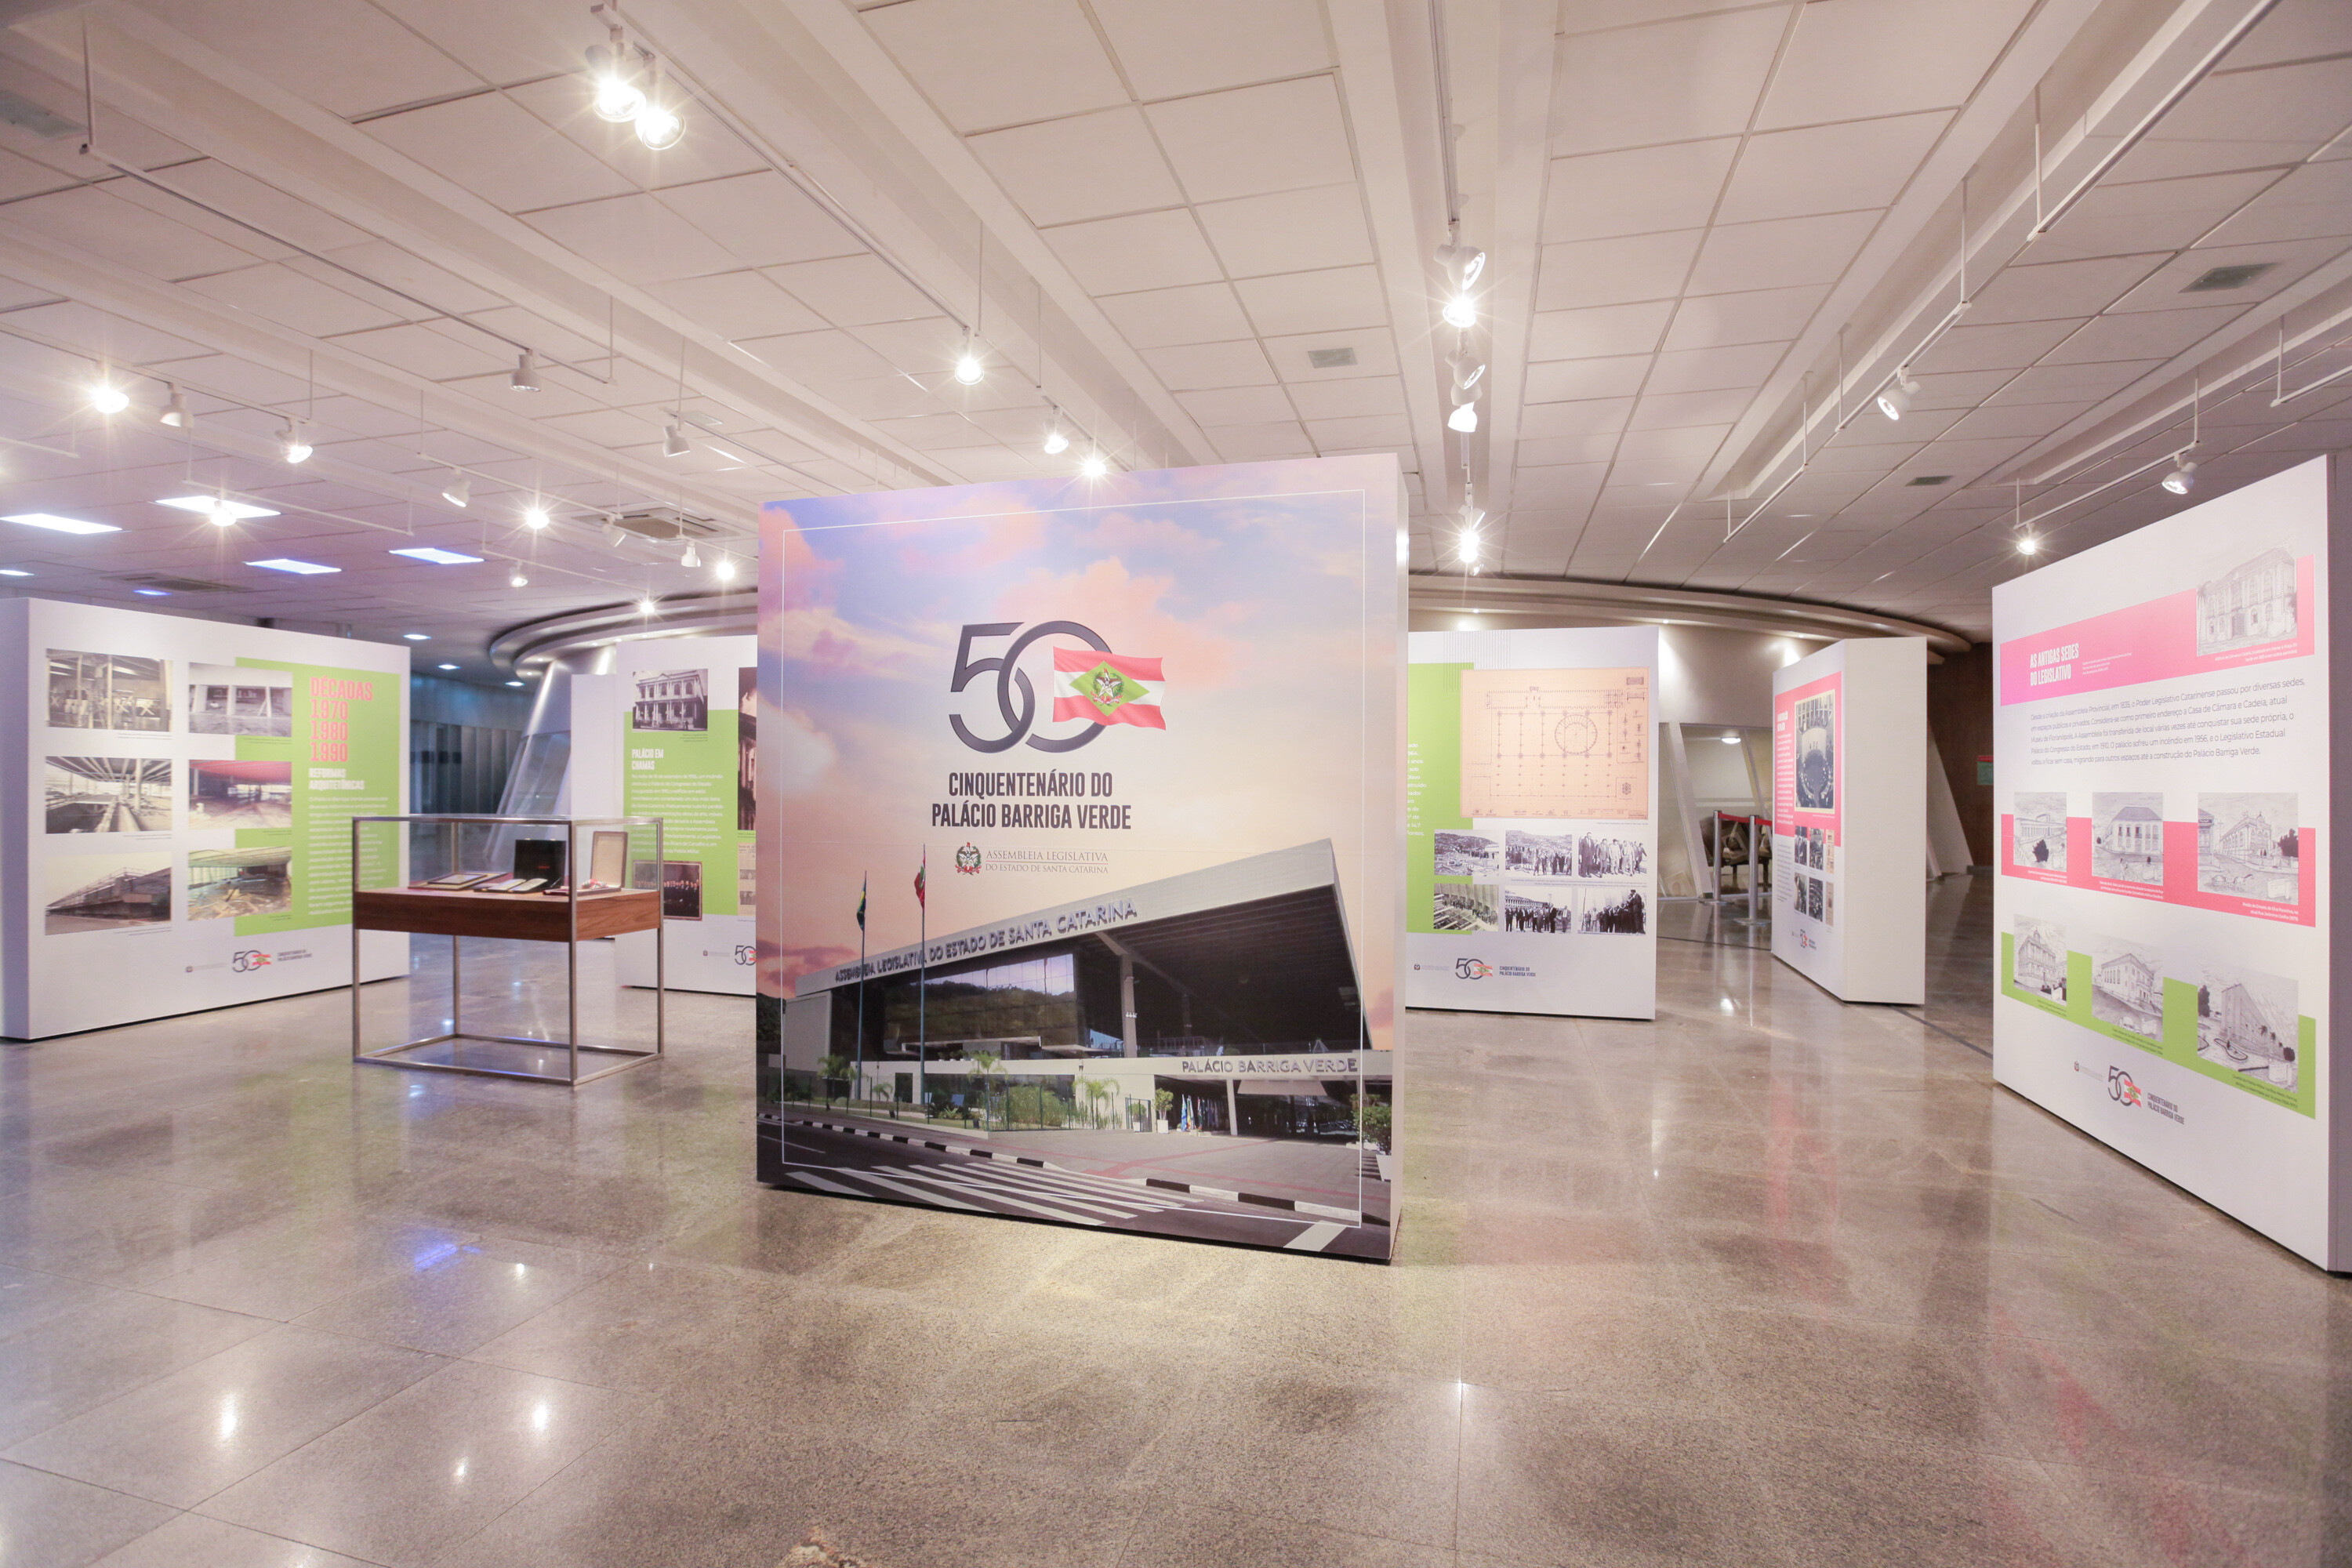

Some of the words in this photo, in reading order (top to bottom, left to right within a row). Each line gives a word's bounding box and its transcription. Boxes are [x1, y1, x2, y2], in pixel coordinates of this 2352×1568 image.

[2031, 653, 2038, 669] AS
[2038, 648, 2060, 666] ANTIGAS
[2061, 643, 2079, 662] SEDES
[2031, 671, 2038, 686] DO
[2038, 664, 2071, 684] LEGISLATIVO
[310, 675, 373, 701] DÉCADAS
[949, 620, 1113, 753] 50
[2136, 698, 2151, 706] Poder
[2152, 695, 2180, 706] Legislativo
[2180, 691, 2216, 701] Catarinense
[2216, 688, 2238, 698] passou
[2240, 686, 2251, 695] por
[2252, 681, 2281, 691] diversas
[2282, 677, 2305, 688] sedes,
[310, 699, 348, 720] 1970
[2135, 712, 2156, 721] primeiro
[2157, 709, 2182, 717] endereço
[2212, 702, 2236, 712] Câmara
[2243, 698, 2267, 708] Cadeia,
[2270, 695, 2288, 706] atual
[310, 720, 348, 741] 1980
[2109, 727, 2134, 736] transferida
[2142, 724, 2154, 733] local
[2187, 720, 2196, 729] até
[2197, 717, 2229, 728] conquistar
[2243, 714, 2259, 724] sede
[2260, 712, 2288, 724] própria,
[2159, 735, 2183, 745] incêndio
[2194, 734, 2209, 744] 1956,
[2220, 730, 2254, 742] Legislativo
[2255, 728, 2285, 739] Estadual
[310, 742, 348, 762] 1990
[632, 747, 654, 758] PALÁCIO
[655, 749, 664, 758] EM
[2154, 750, 2183, 760] construção
[2193, 748, 2215, 758] Palácio
[2216, 746, 2238, 758] Barriga
[2239, 746, 2260, 755] Verde.
[632, 760, 655, 770] CHAMAS
[949, 768, 1086, 800] CINQUENTENÁRIO
[1091, 772, 1113, 797] DO
[932, 800, 996, 828] PALÁCIO
[1001, 804, 1073, 829] BARRIGA
[1076, 804, 1131, 829] VERDE
[986, 851, 1044, 860] ASSEMBLEIA
[1047, 851, 1108, 862] LEGISLATIVA
[1000, 864, 1029, 873] ESTADO
[1069, 866, 1109, 874] CATARINA
[835, 962, 876, 982] ASSEMBEIA
[929, 946, 943, 962] DO
[946, 935, 987, 959] ESTADO
[989, 929, 1005, 949] DE
[1008, 919, 1052, 945] SANTA
[1057, 898, 1137, 934] CATARINA
[232, 950, 262, 973] 50
[1455, 958, 1484, 980] 50
[1182, 1058, 1233, 1073] PALÁCIO
[1239, 1059, 1301, 1073] BARRIGA
[1302, 1058, 1358, 1073] VERDE
[2107, 1065, 2133, 1106] 50
